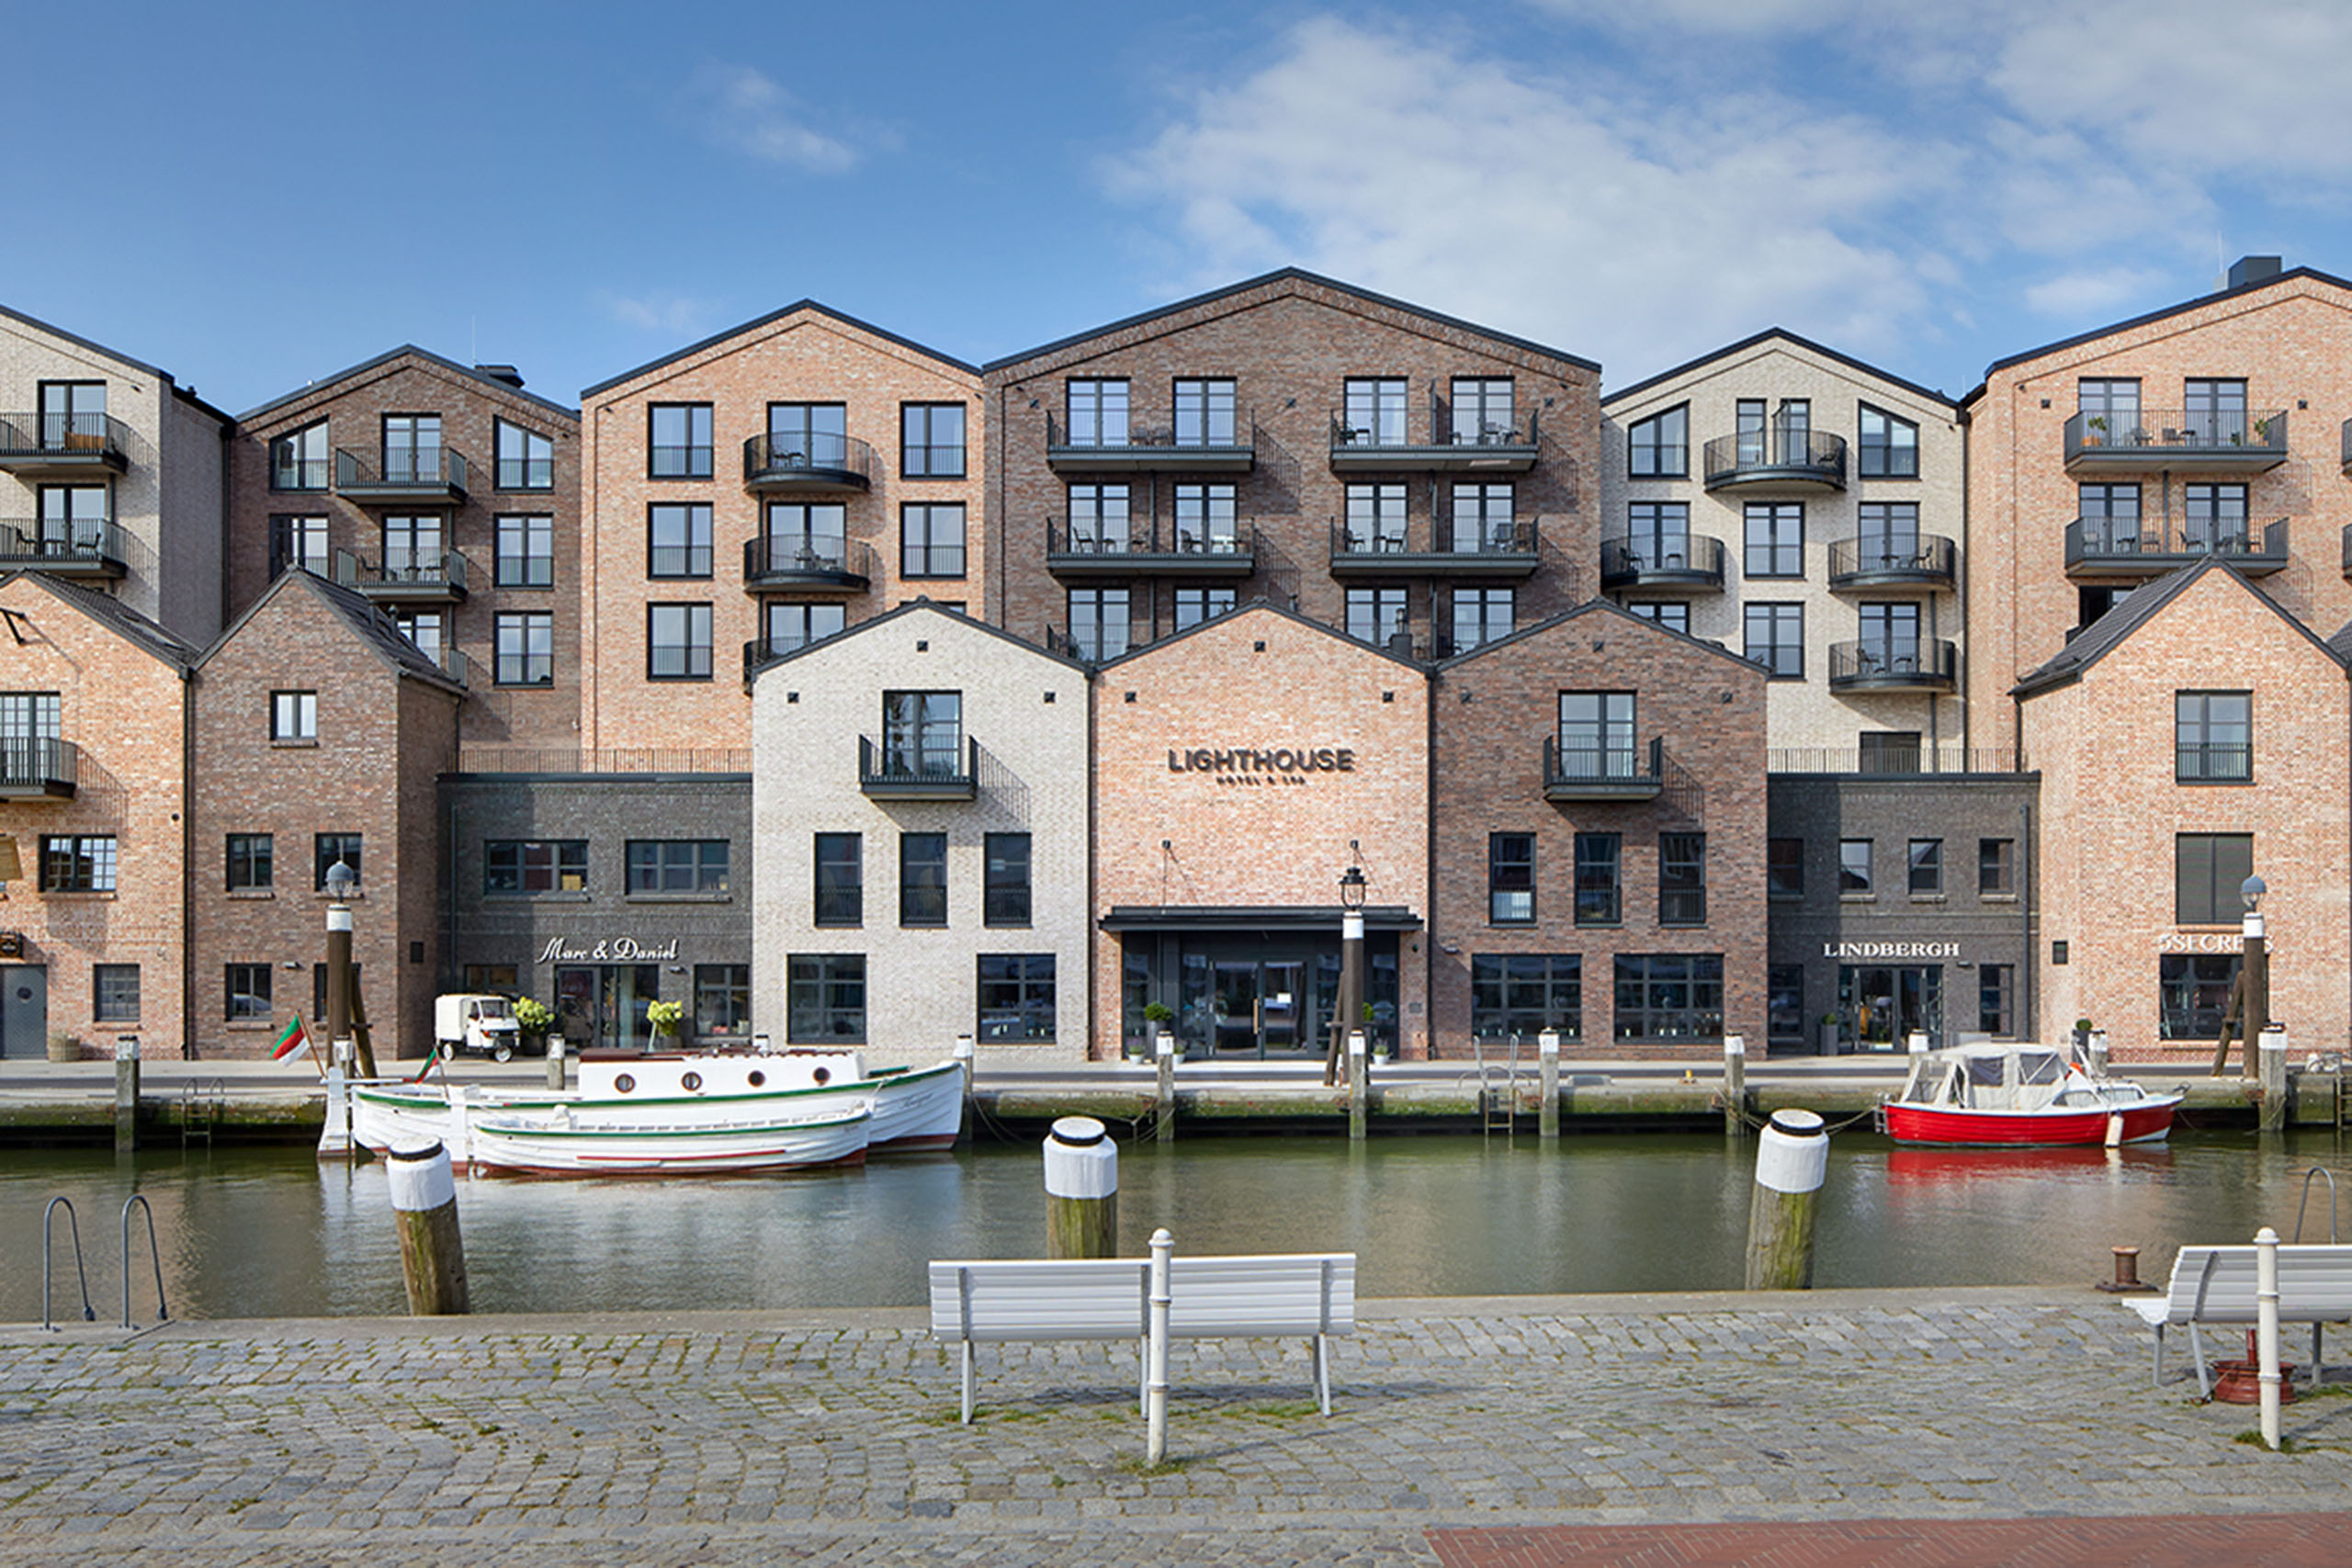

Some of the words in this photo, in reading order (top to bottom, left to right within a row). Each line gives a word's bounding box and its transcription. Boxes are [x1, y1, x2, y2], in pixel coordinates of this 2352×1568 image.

[1168, 749, 1355, 773] LIGHTHOUSE
[537, 937, 587, 963] Marc
[593, 940, 608, 960] &
[613, 937, 678, 961] Daniel
[1824, 942, 1960, 957] LINDBERGH
